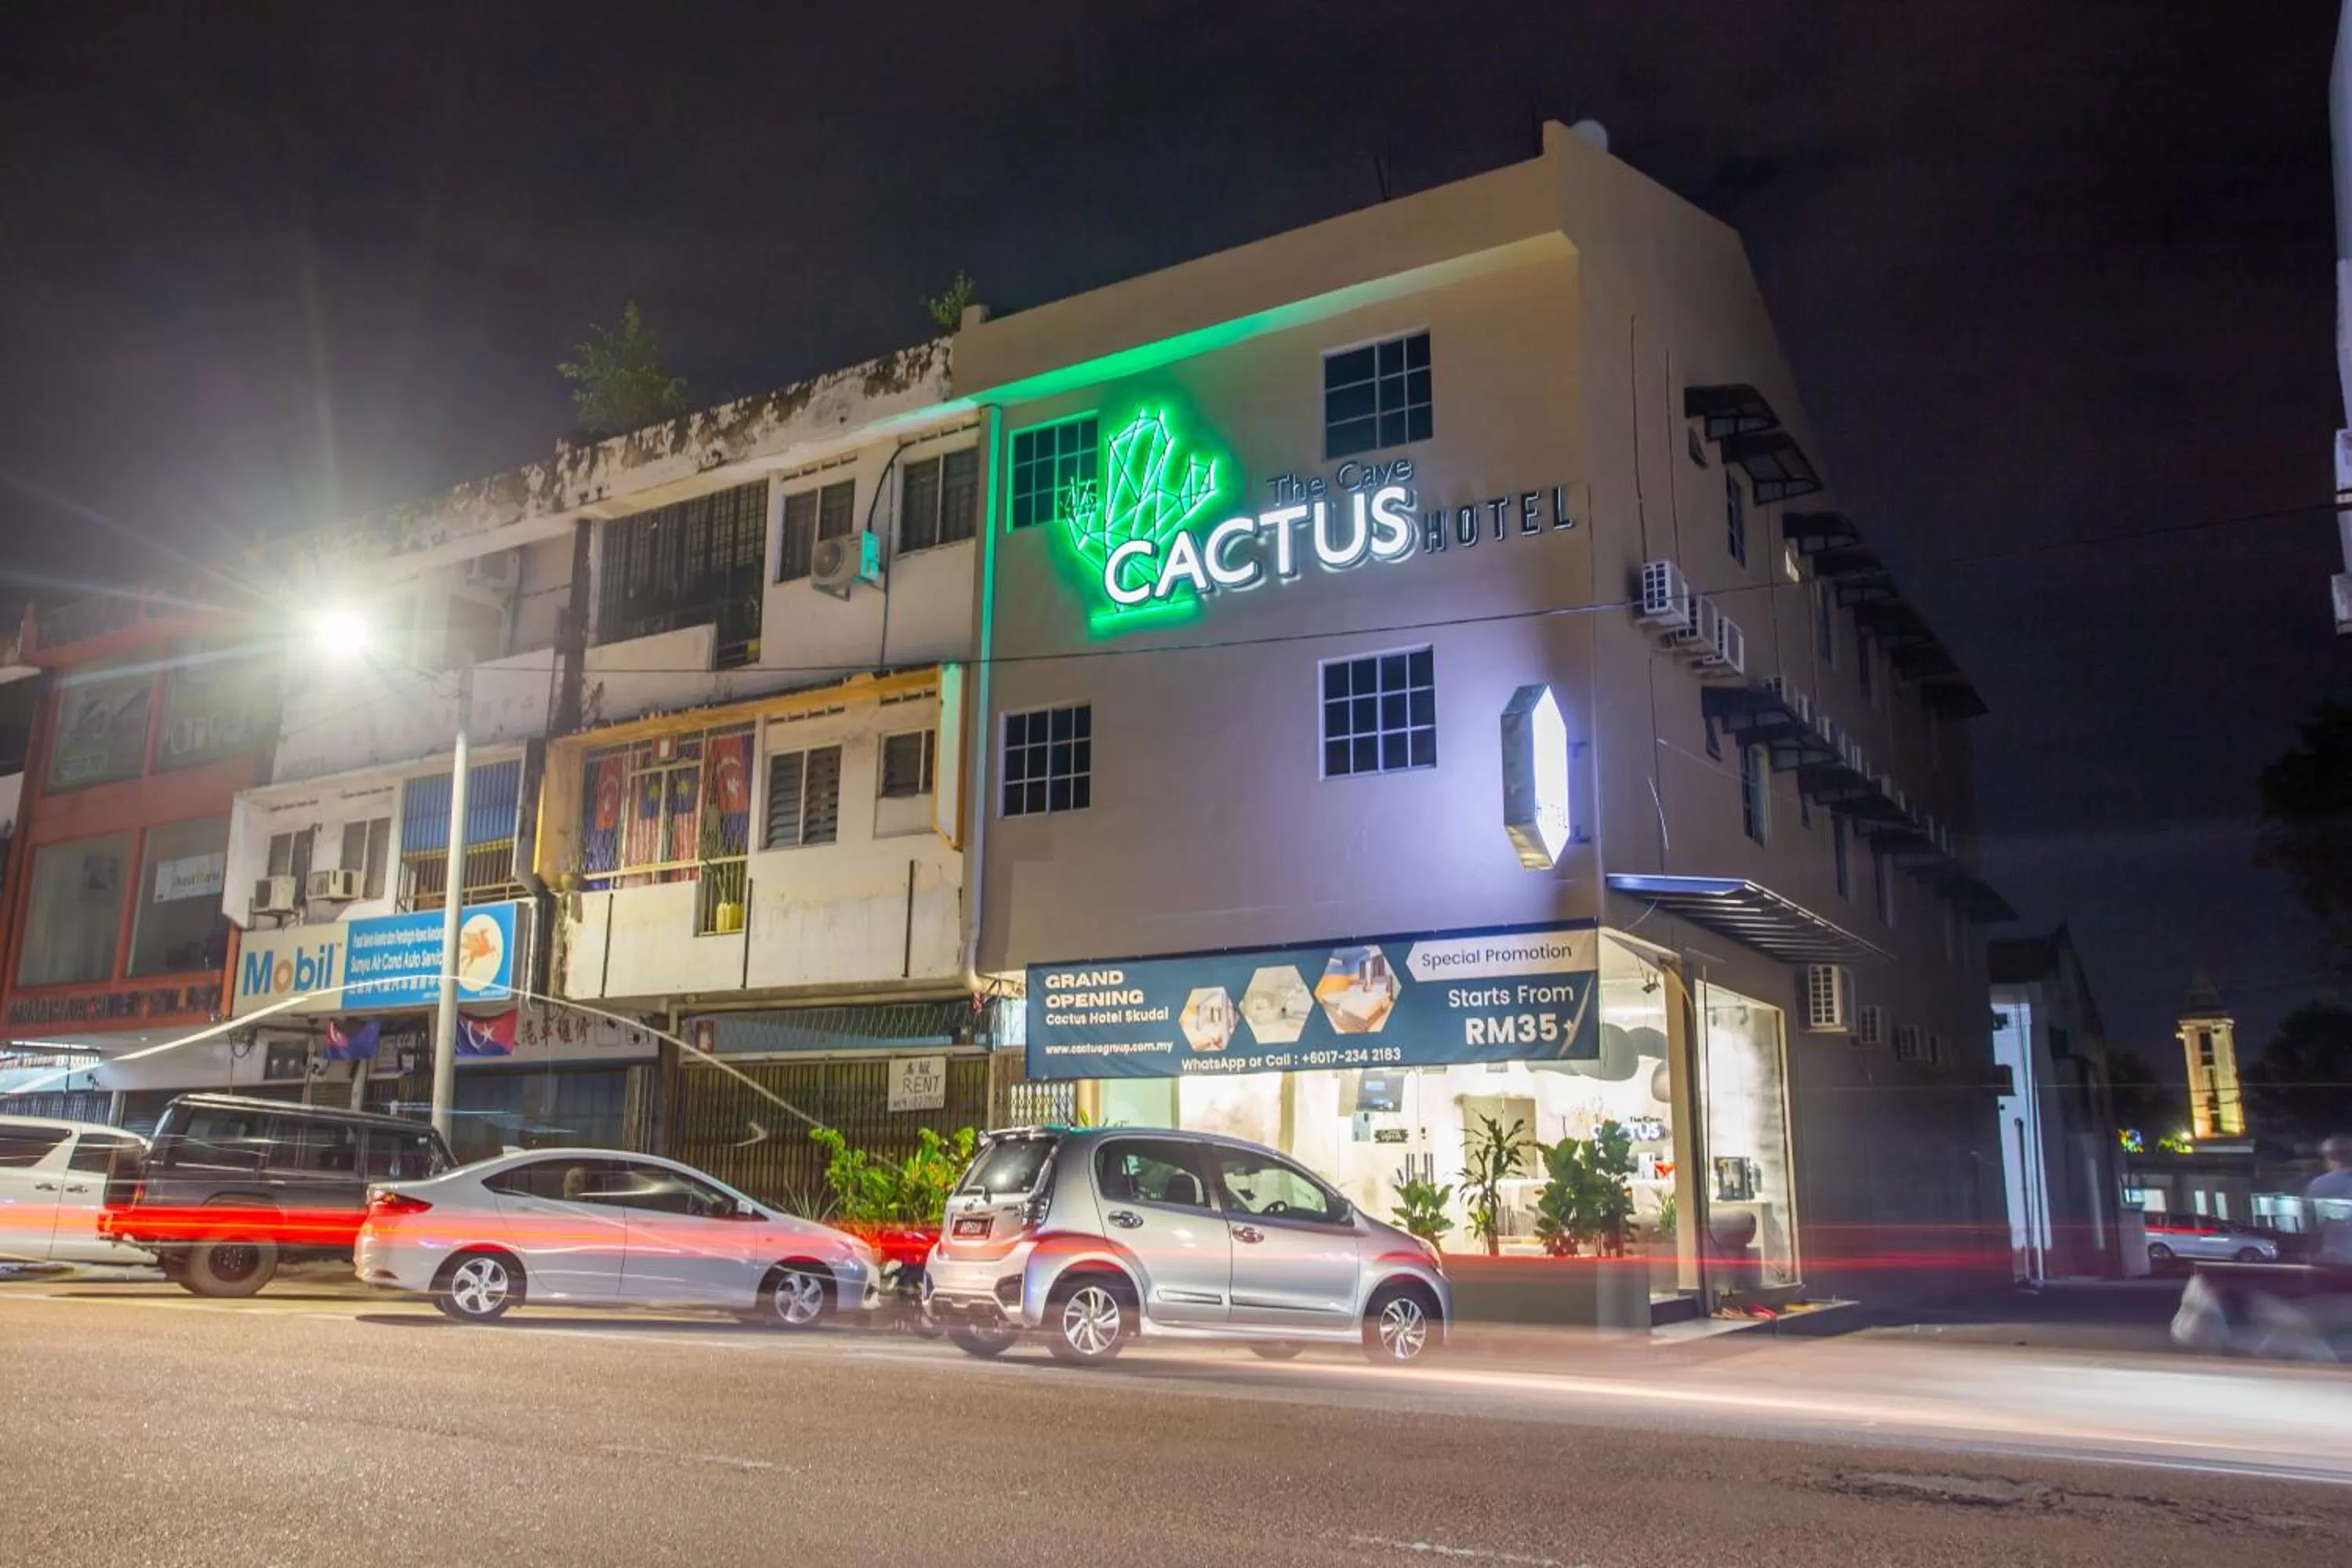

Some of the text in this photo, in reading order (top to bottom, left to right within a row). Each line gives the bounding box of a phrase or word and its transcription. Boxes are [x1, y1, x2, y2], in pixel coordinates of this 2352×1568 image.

[1267, 458, 1414, 506] The Cave
[1104, 486, 1575, 605] CACTUS HOTEL
[403, 949, 421, 969] Auto
[422, 948, 445, 967] Servic
[1421, 943, 1573, 971] Special Promotion
[242, 942, 335, 996] Mobil
[1045, 970, 1123, 989] GRAND
[1045, 989, 1144, 1008] OPENING
[1448, 984, 1574, 1008] Starts From
[1046, 1006, 1170, 1025] Cactus Hotel Skudai
[1465, 1012, 1559, 1045] RM35
[1044, 1040, 1174, 1056] www.cactusgroup.com.my
[1181, 1057, 1246, 1073] WhatsApp
[1249, 1058, 1262, 1068] or
[1265, 1053, 1291, 1067] Call
[1301, 1050, 1369, 1065] +6017-234
[902, 1075, 941, 1094] RENT
